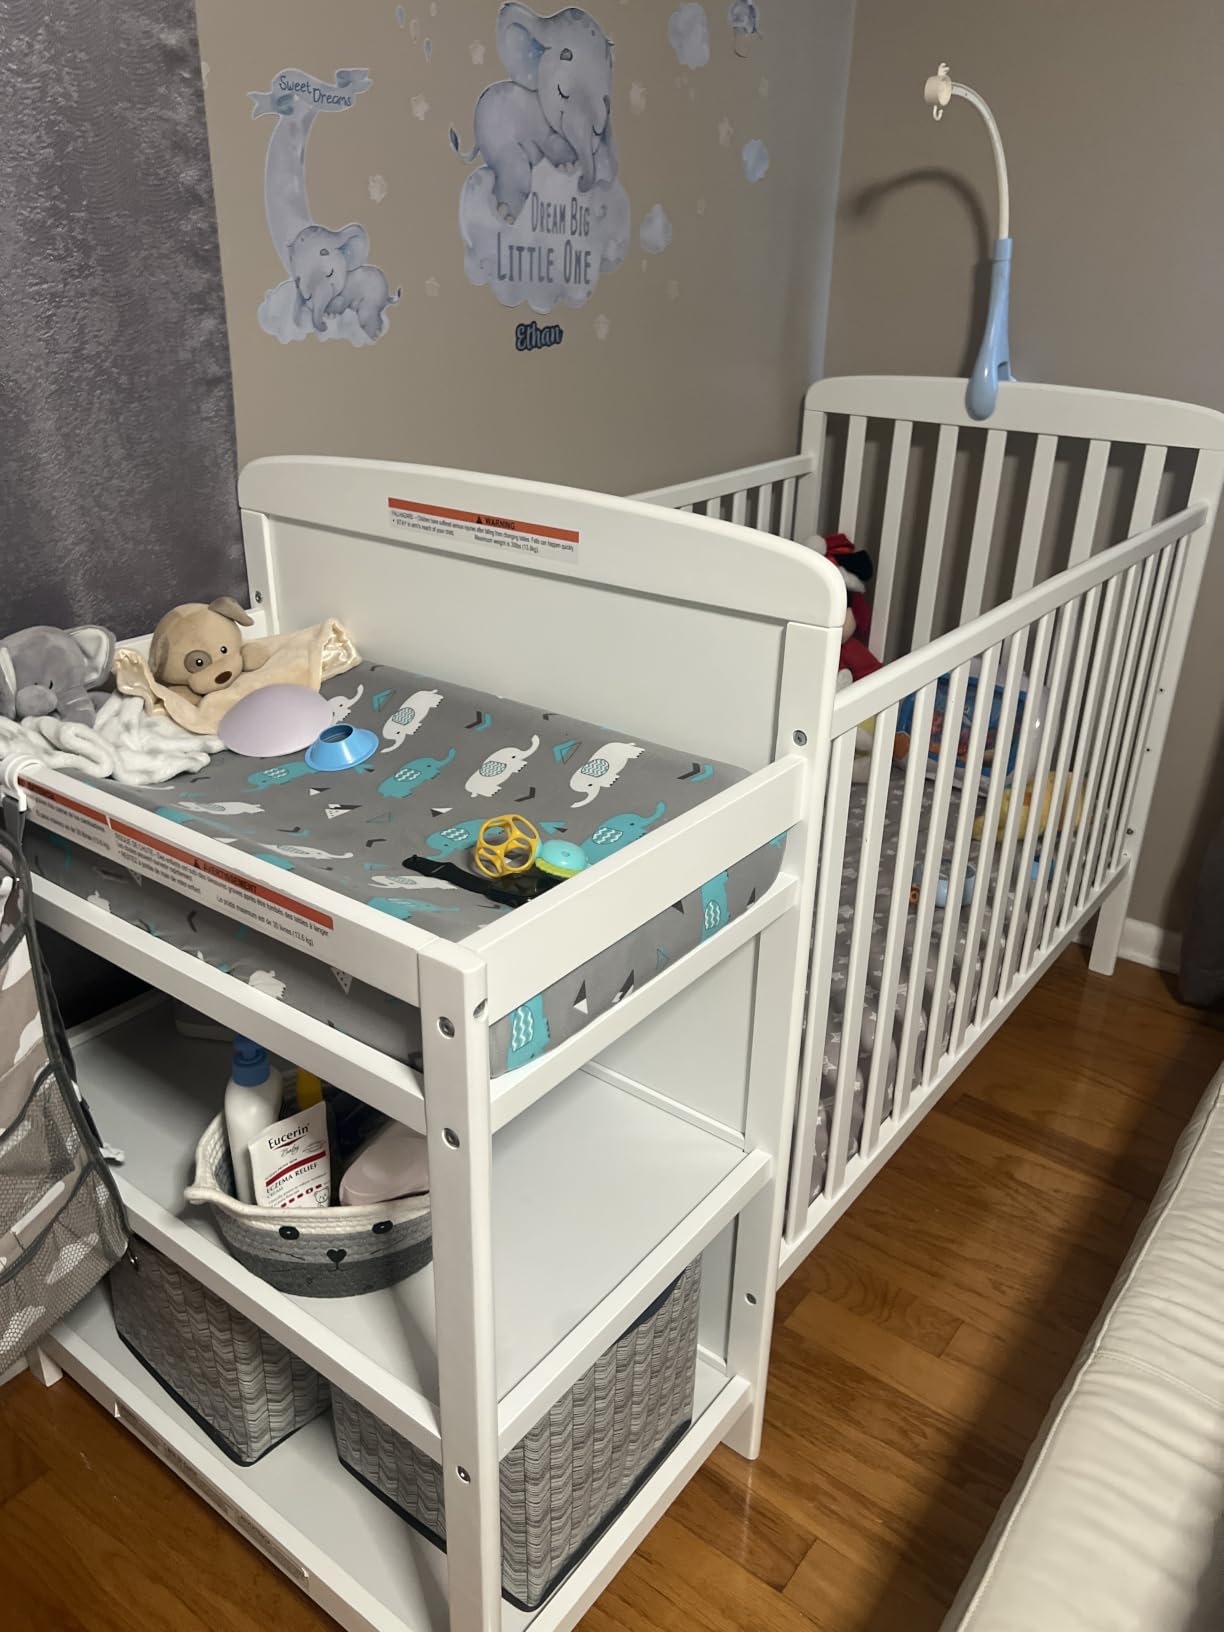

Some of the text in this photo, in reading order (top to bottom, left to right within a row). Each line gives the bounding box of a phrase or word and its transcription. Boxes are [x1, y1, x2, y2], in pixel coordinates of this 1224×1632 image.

[280, 76, 312, 94] Sweet
[313, 88, 352, 107] Dreams
[531, 192, 590, 237] DREAM BIG
[497, 231, 554, 283] LITTLE
[516, 321, 564, 351] Ethan
[485, 518, 515, 530] WARNING
[268, 1125, 309, 1149] Eucerin
[266, 1174, 293, 1194] ECZEMA
[295, 1162, 318, 1177] RELIEF
